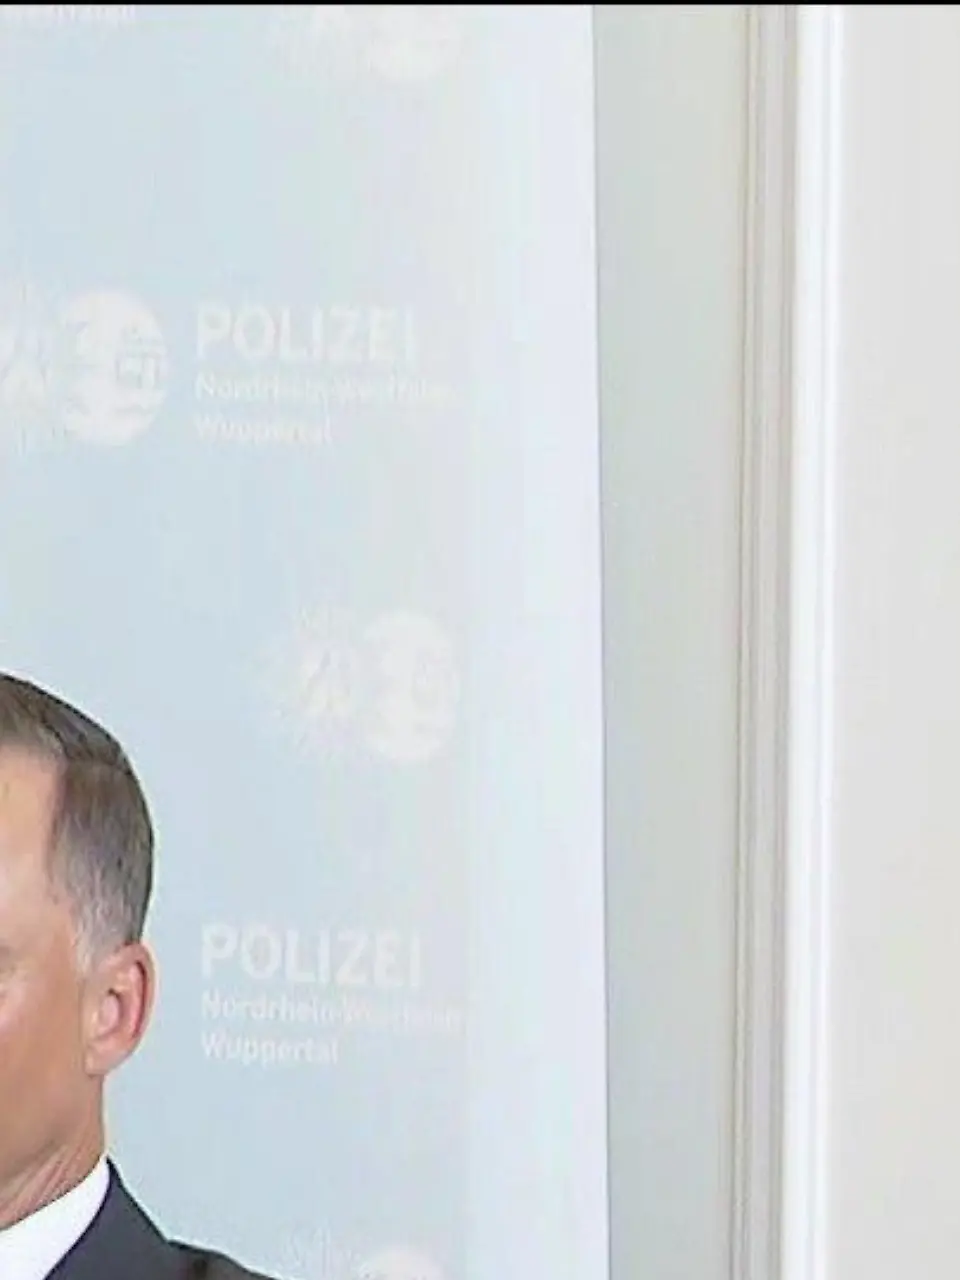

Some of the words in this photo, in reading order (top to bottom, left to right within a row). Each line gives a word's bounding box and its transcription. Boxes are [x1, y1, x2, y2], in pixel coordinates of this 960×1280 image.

[197, 302, 418, 361] POLIZEI
[201, 922, 422, 989] POLIZEI
[201, 1031, 340, 1069] Wuppertal
